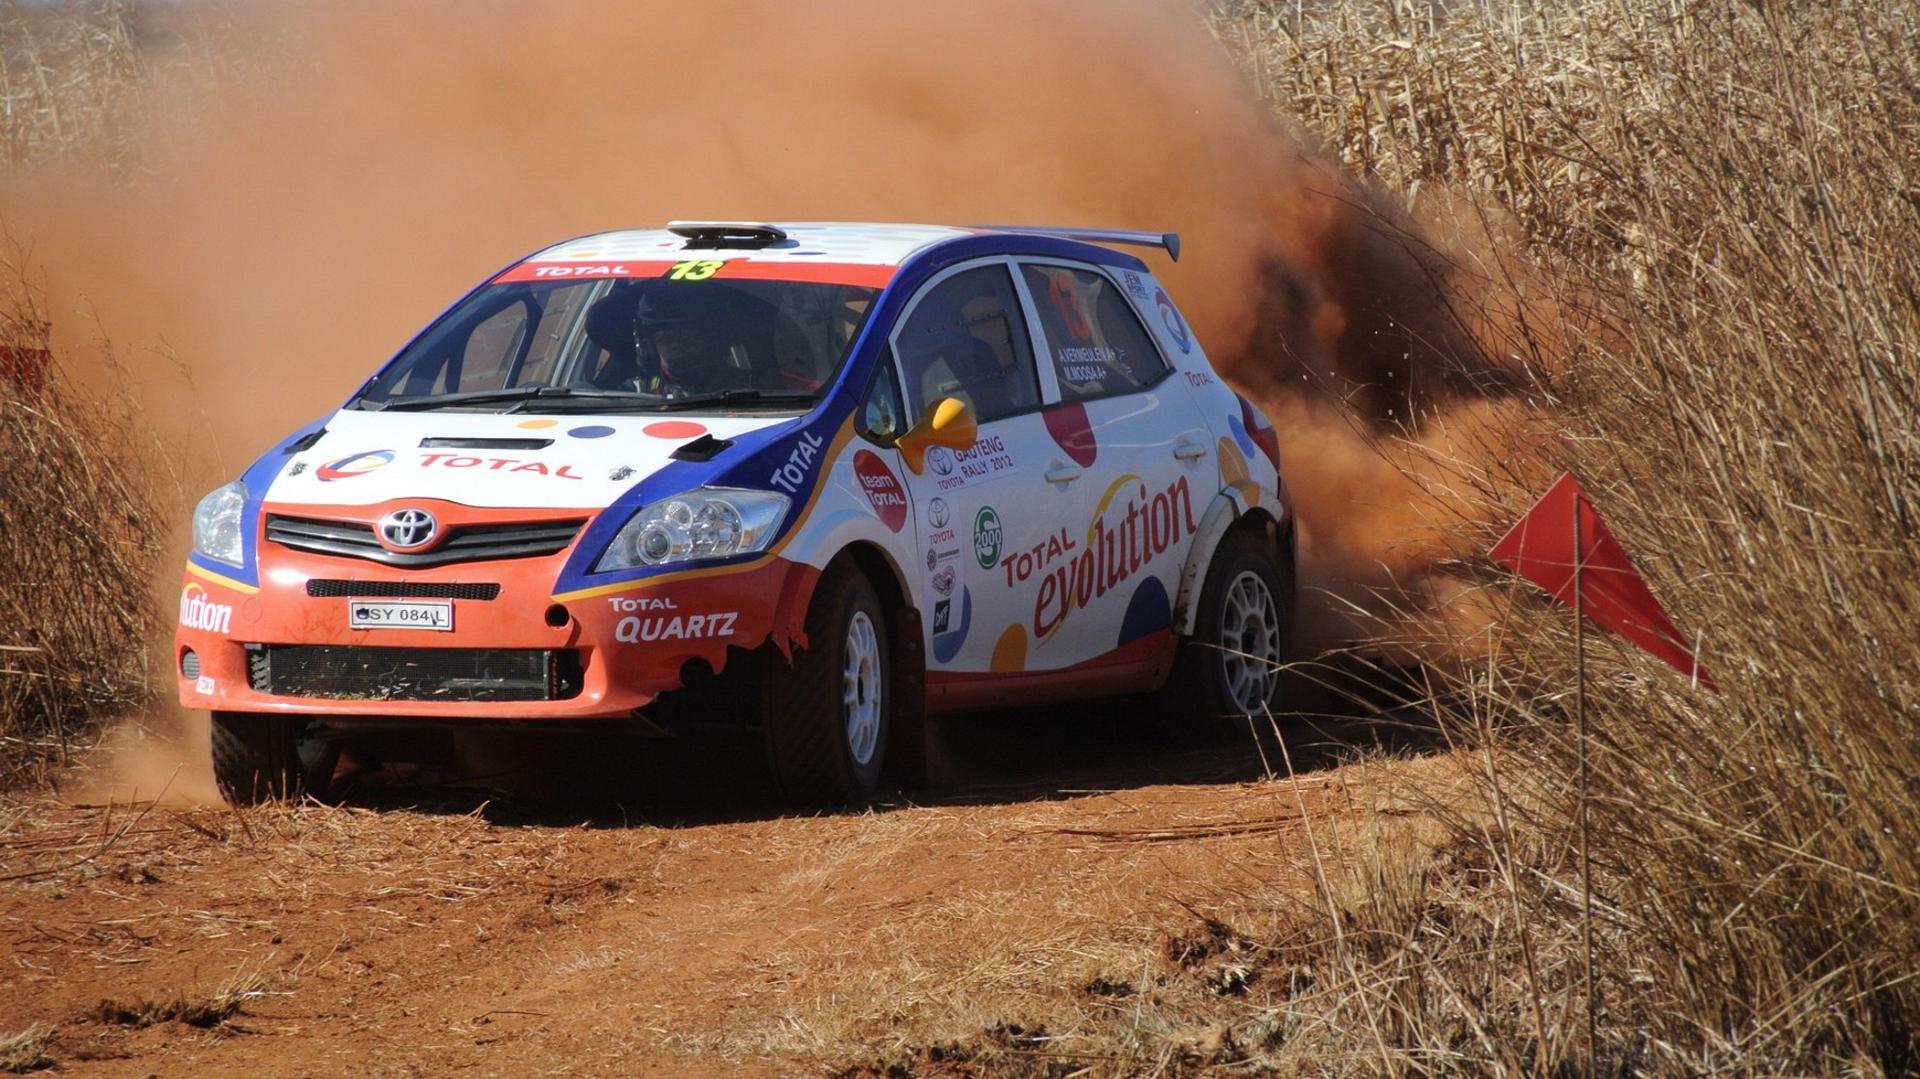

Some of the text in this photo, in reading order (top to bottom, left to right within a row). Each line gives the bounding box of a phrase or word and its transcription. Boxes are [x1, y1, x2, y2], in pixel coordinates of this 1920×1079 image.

[535, 265, 629, 277] TOTAL
[670, 260, 724, 281] 13
[1184, 371, 1214, 387] TOTAL
[953, 436, 1005, 463] GAUTENG
[420, 453, 584, 481] TOTAL
[769, 430, 824, 493] TOTAL
[961, 453, 1014, 480] RALLY 2012
[859, 473, 895, 488] team
[937, 476, 966, 491] TOYOTA
[866, 490, 906, 506] TOTAL
[929, 529, 955, 545] TOYOTA
[975, 528, 1002, 549] 2000
[1001, 527, 1077, 588] TOTAL
[1034, 475, 1198, 638] evolution
[399, 609, 429, 621] 084
[435, 610, 446, 622] L
[608, 597, 678, 613] TOTAL
[615, 612, 738, 643] QUARTZ
